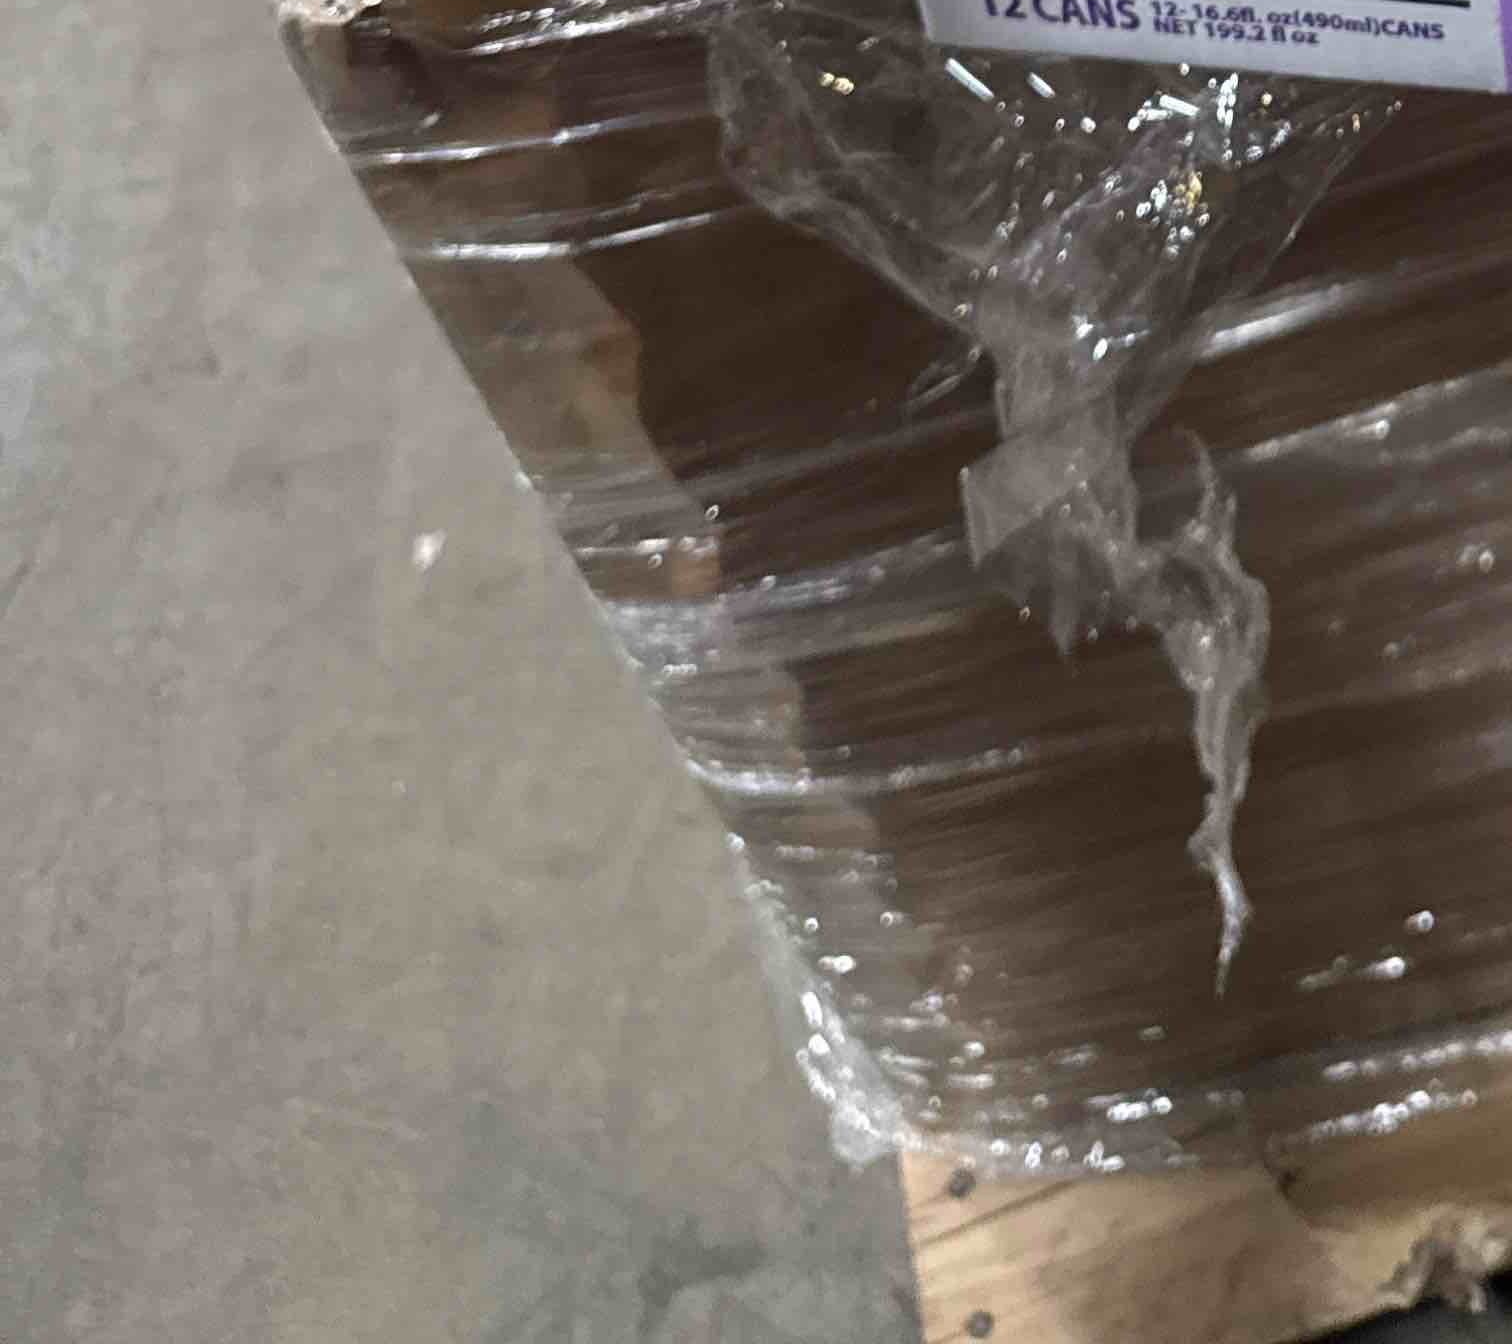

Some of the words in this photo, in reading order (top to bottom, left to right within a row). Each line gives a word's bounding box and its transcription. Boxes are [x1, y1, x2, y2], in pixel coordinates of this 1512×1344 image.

[1151, 16, 1199, 37] NET
[1204, 20, 1269, 42] 199.2
[1289, 31, 1320, 46] oz
